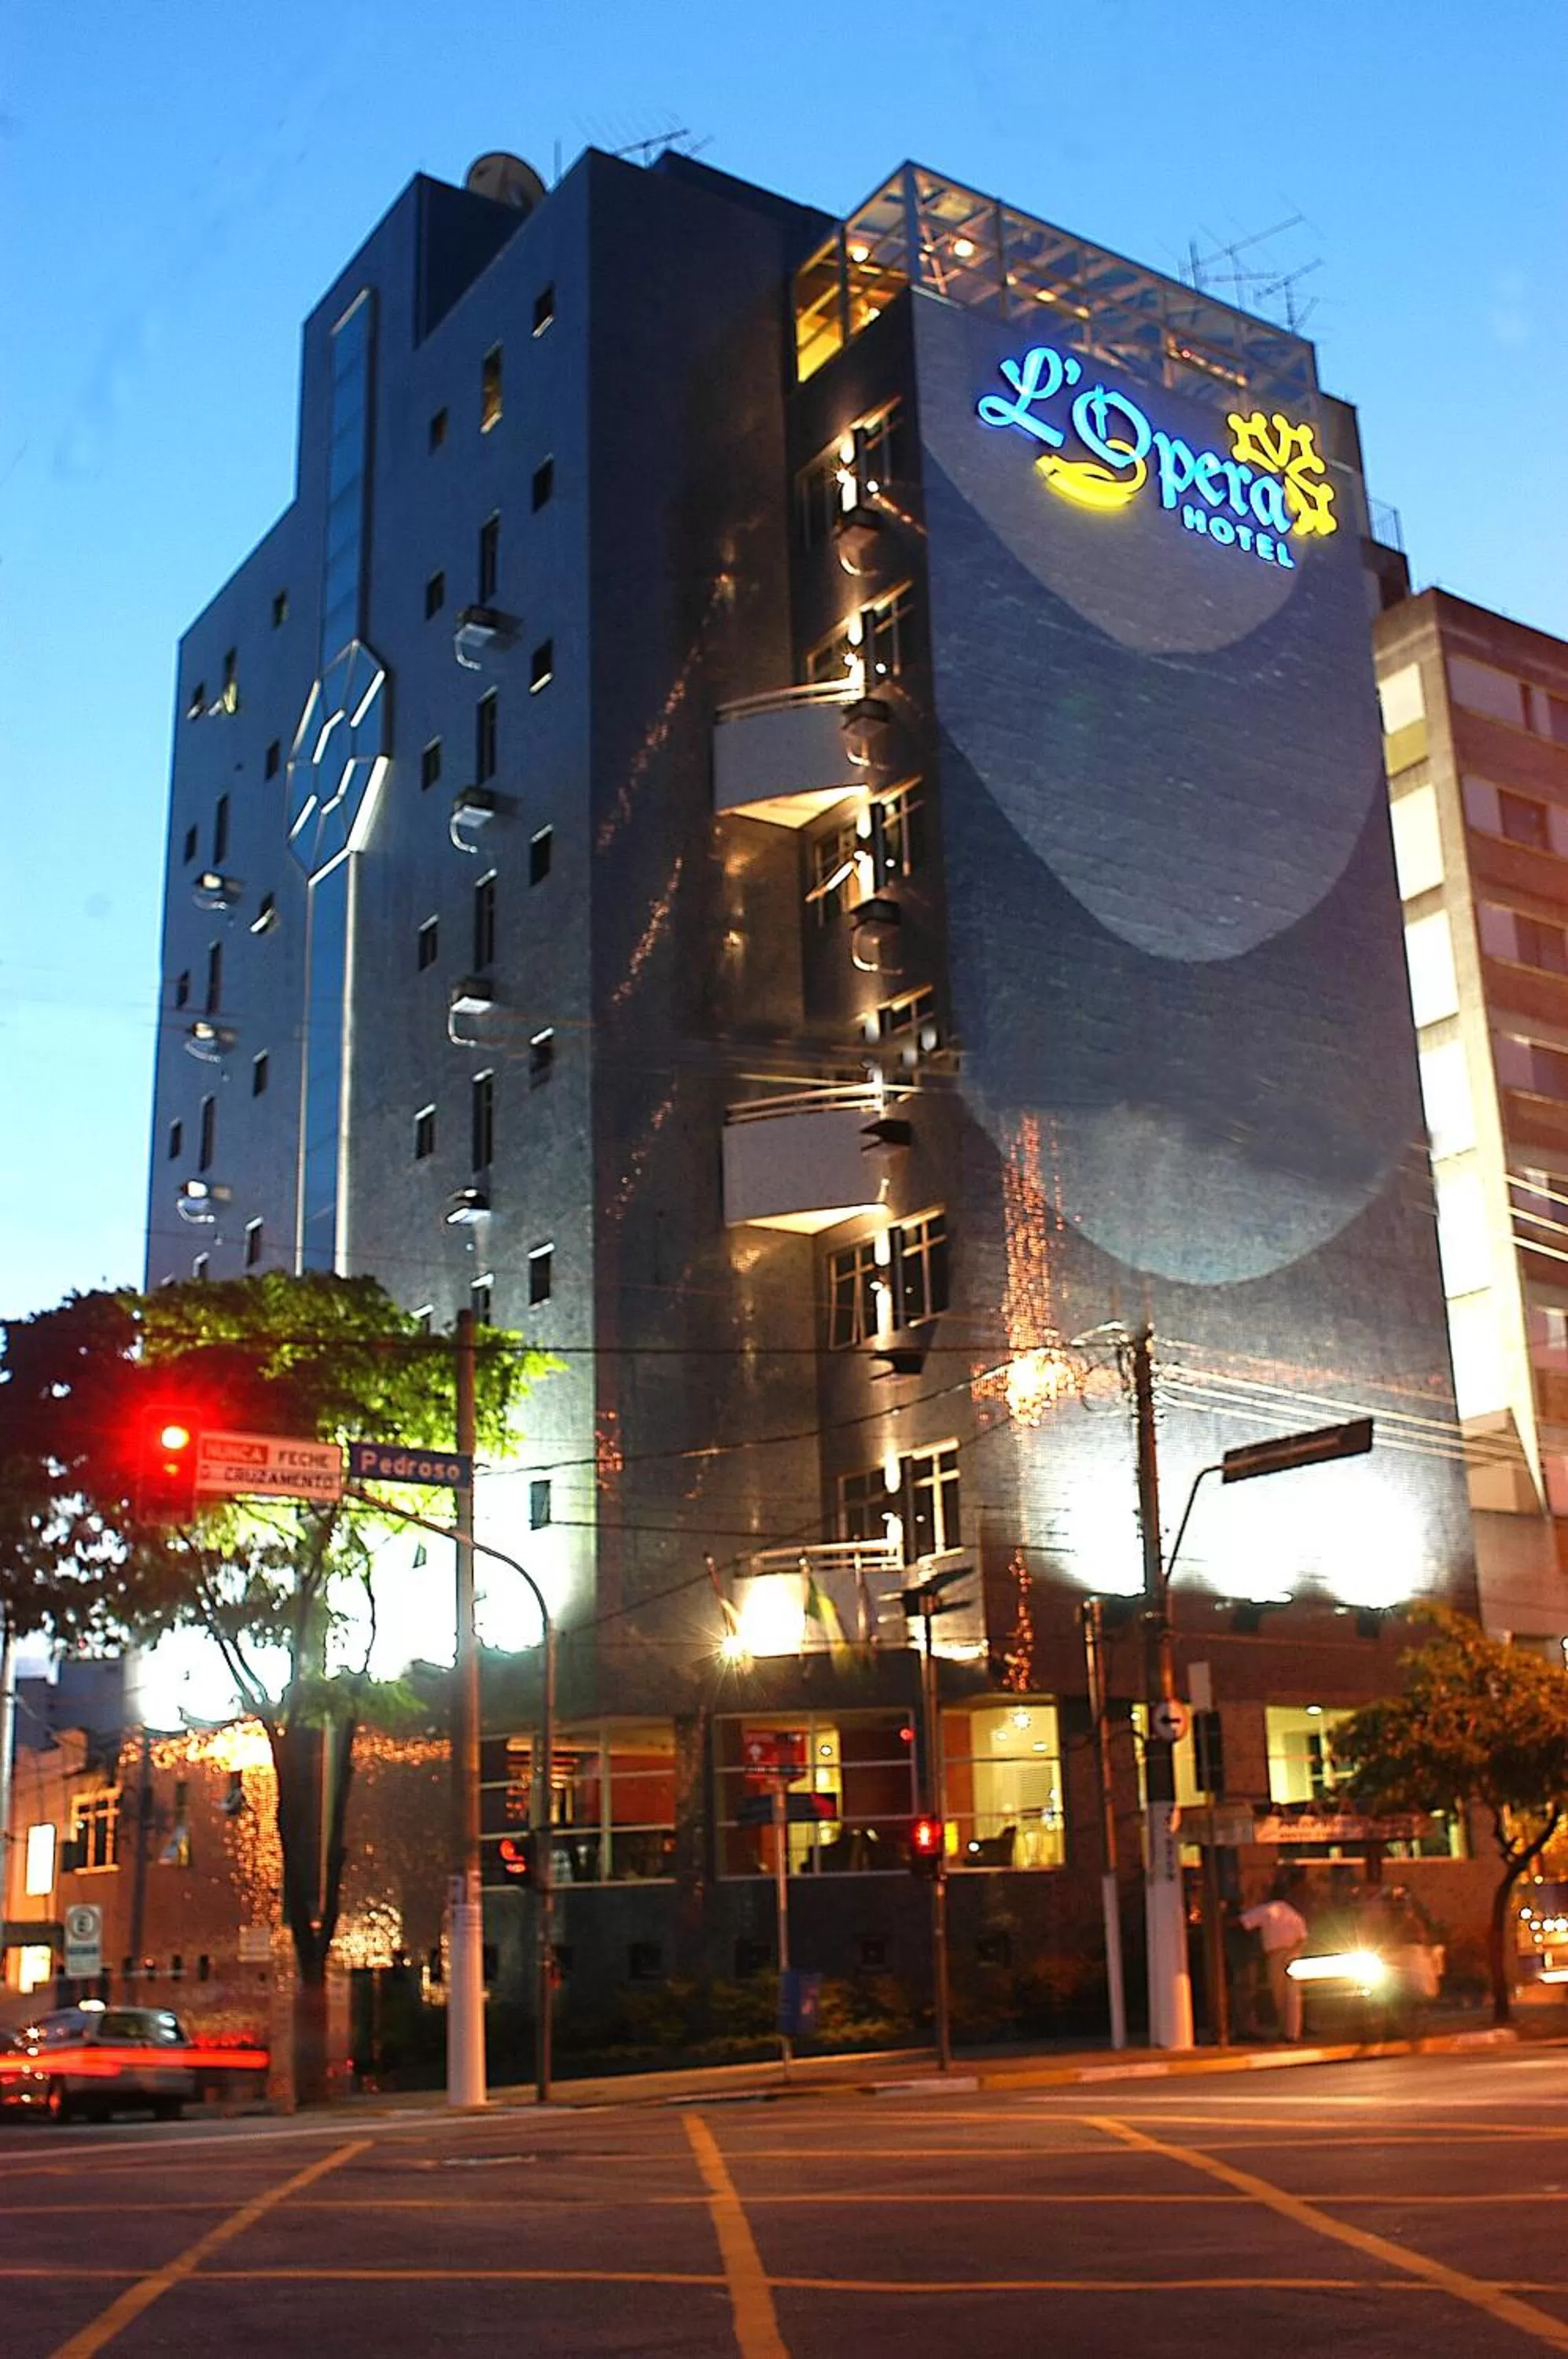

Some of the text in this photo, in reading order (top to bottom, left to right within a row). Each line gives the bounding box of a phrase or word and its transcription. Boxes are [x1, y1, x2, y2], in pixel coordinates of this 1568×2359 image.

[1182, 504, 1296, 570] HOTEL
[278, 1450, 329, 1468] FECHE
[360, 1449, 462, 1481] Pedroso
[224, 1466, 334, 1489] CRUZAMENTO
